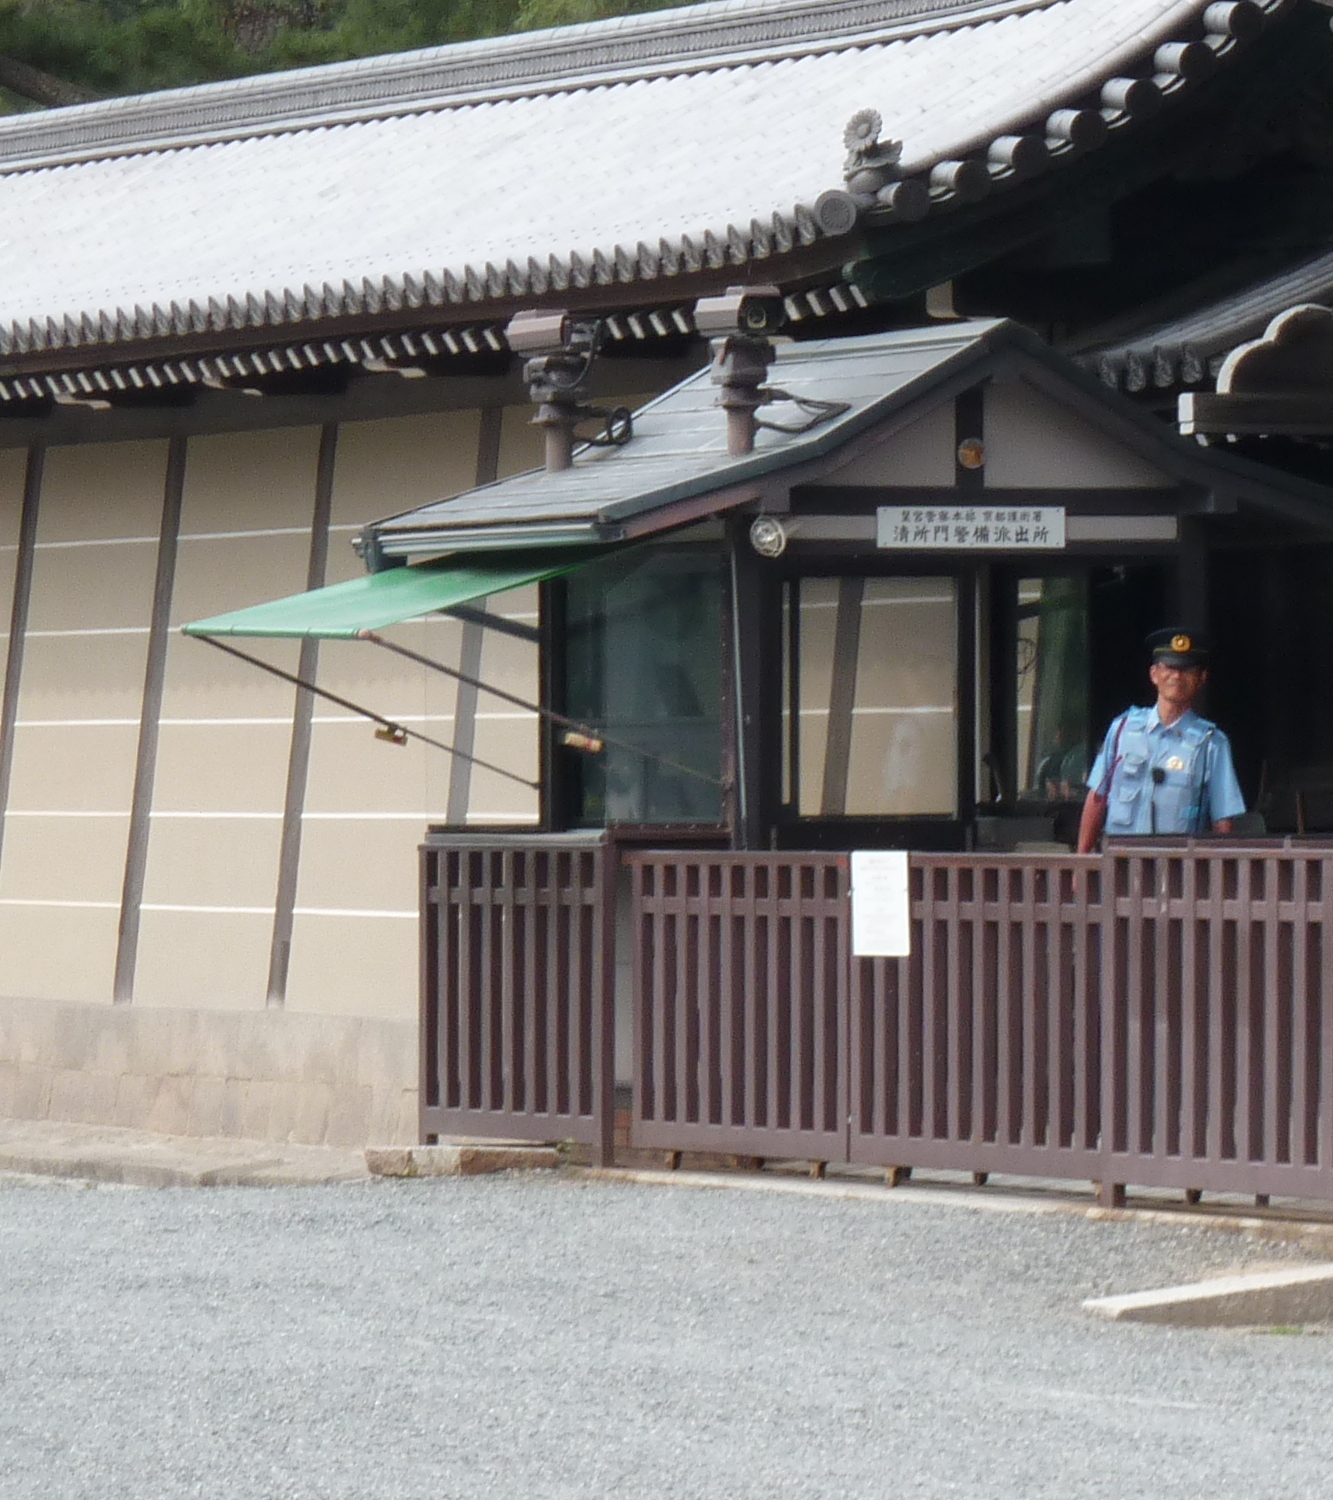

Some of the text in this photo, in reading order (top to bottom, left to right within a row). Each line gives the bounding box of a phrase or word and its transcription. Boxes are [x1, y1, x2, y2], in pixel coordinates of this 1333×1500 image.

[893, 525, 1049, 543] 清所門警備派出所
